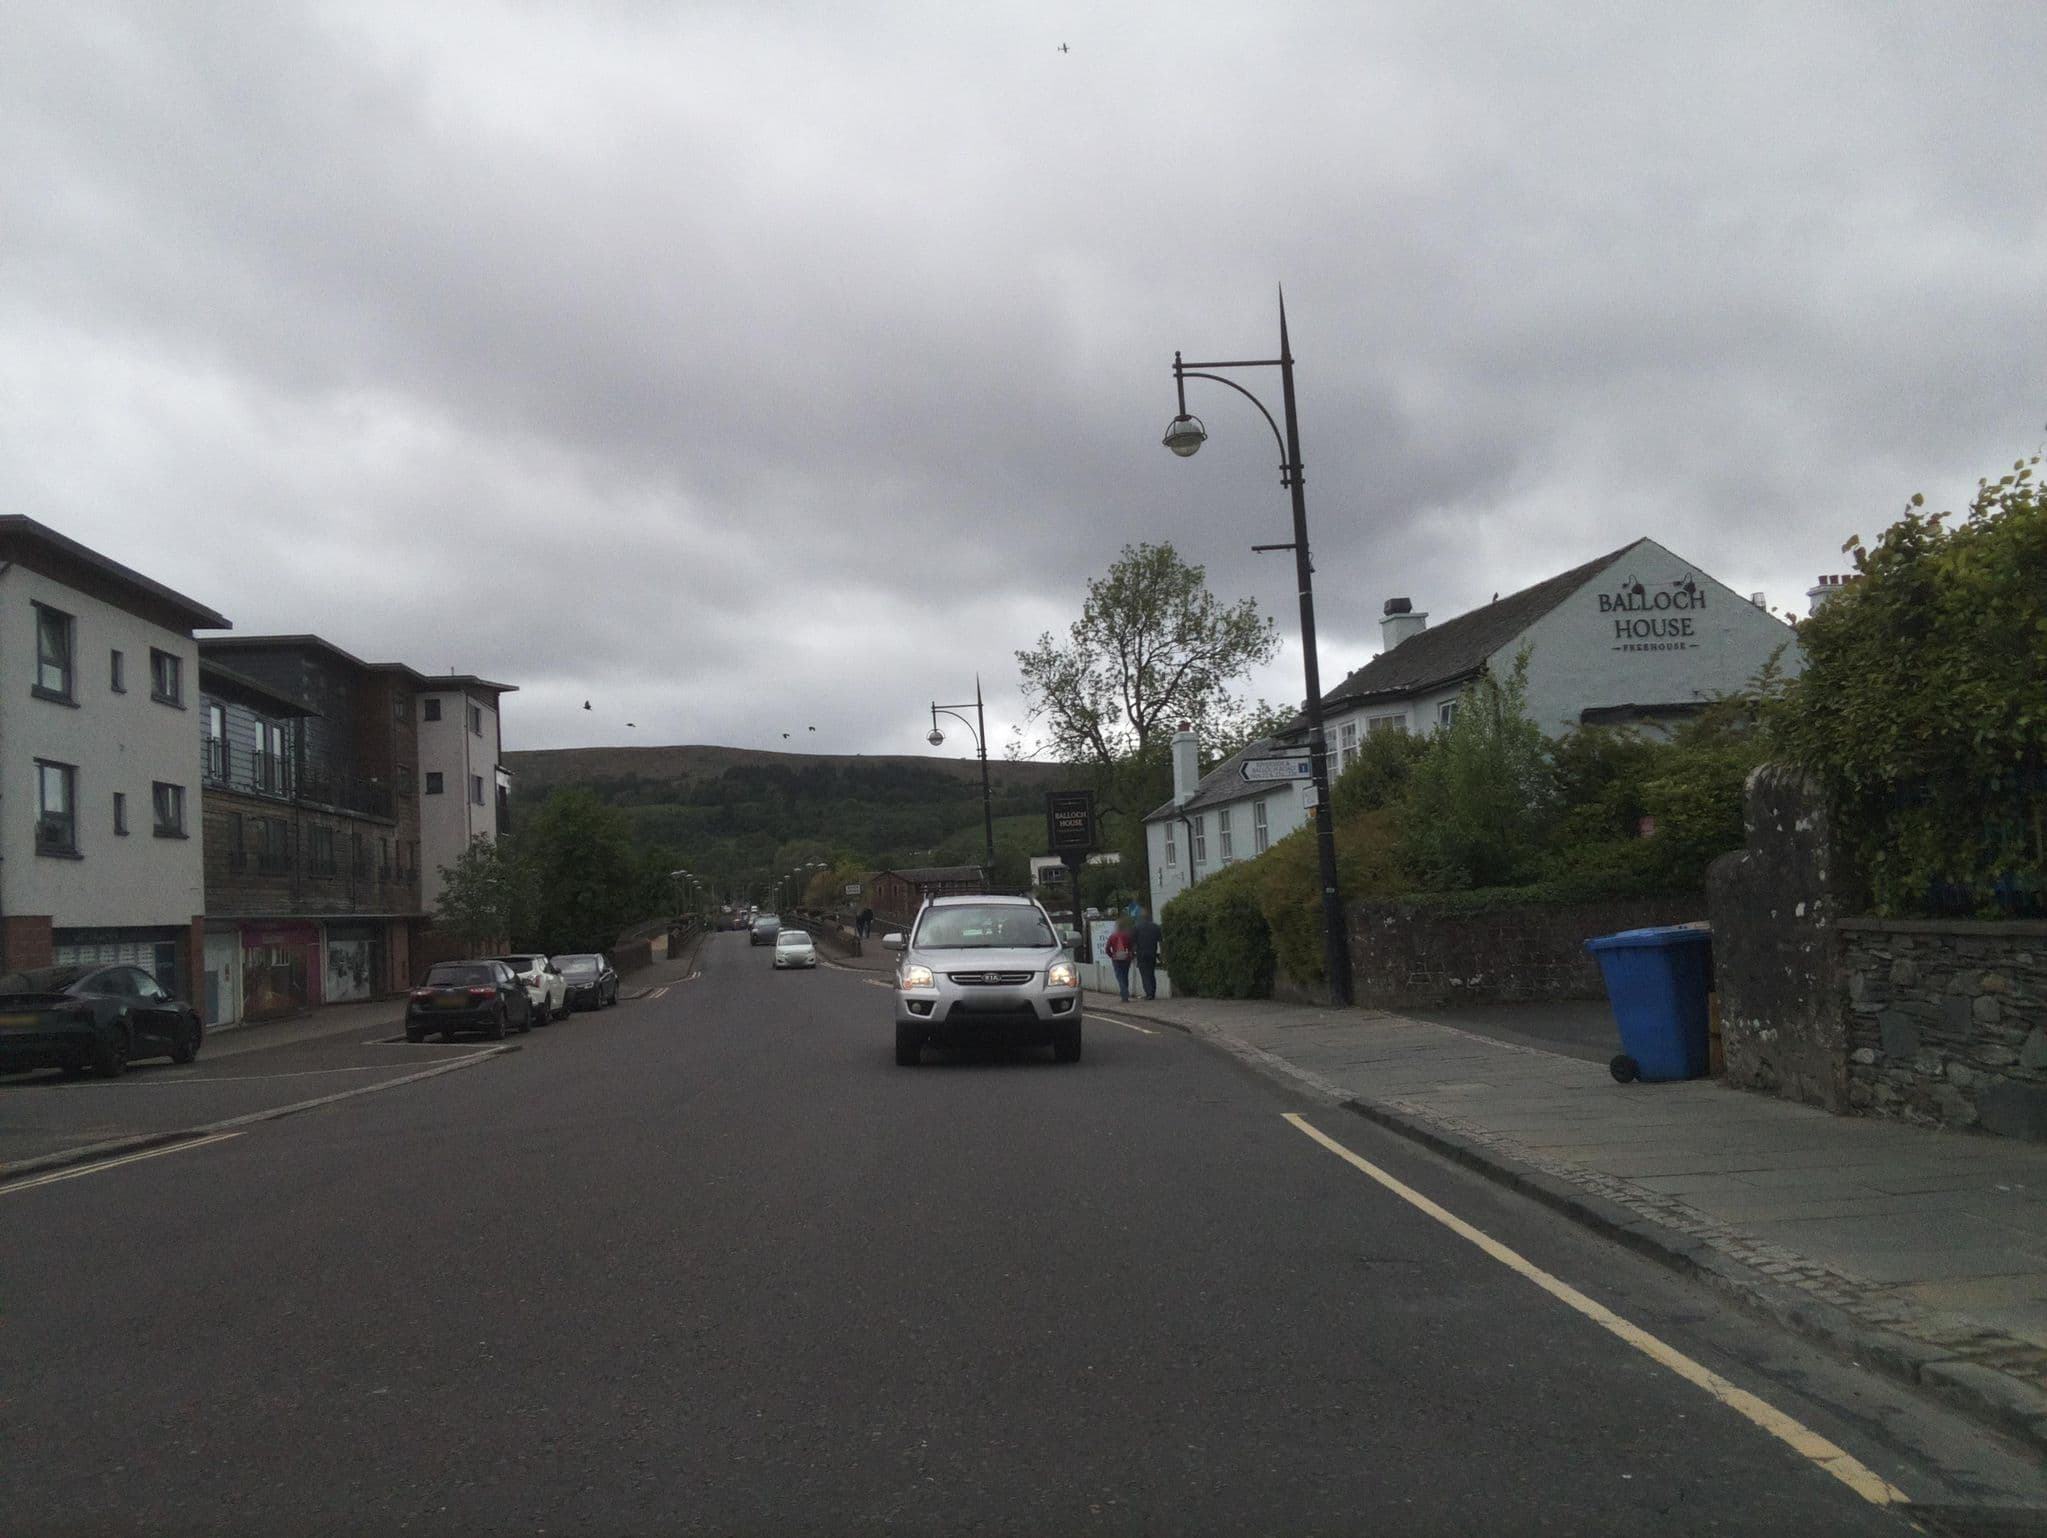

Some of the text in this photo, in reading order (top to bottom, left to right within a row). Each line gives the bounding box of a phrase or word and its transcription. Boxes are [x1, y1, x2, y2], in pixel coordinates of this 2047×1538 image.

[1598, 590, 1706, 612] BALLOCH
[1615, 617, 1694, 638] HOUSE
[1623, 642, 1686, 651] FREEHOUSE
[1055, 811, 1087, 819] BALLOCH
[1059, 819, 1083, 827] HOUSE
